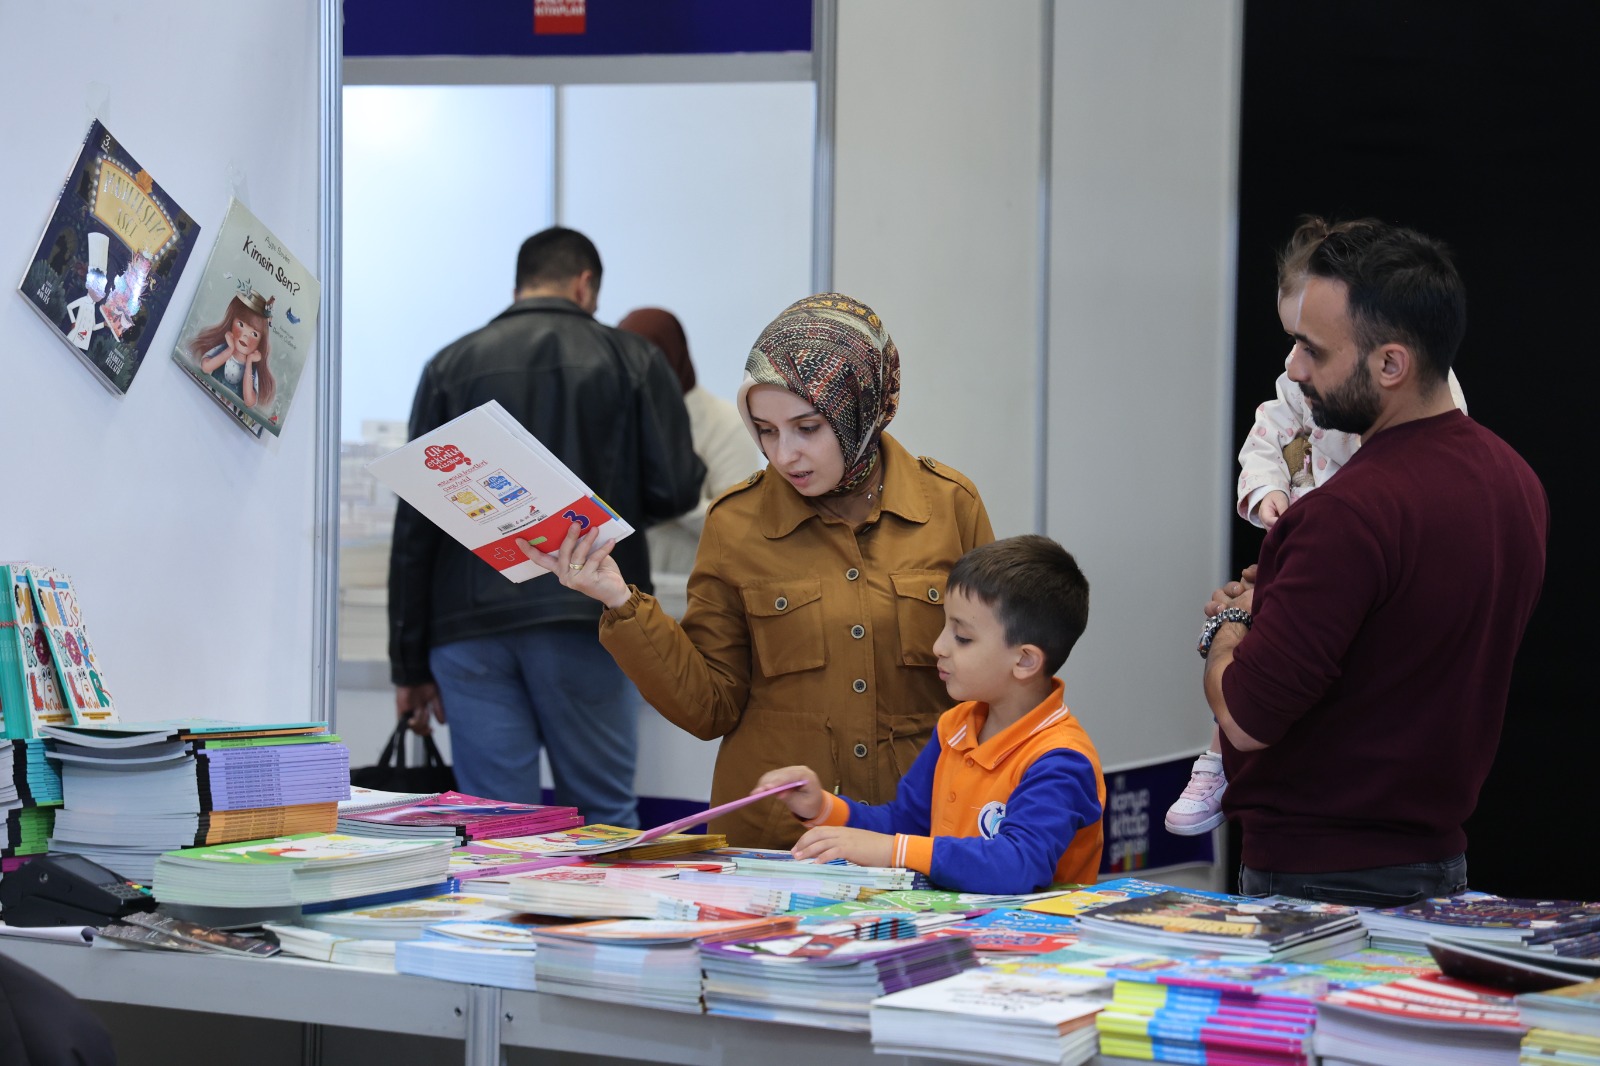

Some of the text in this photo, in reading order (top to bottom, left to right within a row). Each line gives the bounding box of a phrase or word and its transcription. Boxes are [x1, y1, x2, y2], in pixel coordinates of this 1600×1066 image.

[242, 235, 301, 296] Kimsin Sen?
[427, 447, 461, 468] etkinlik
